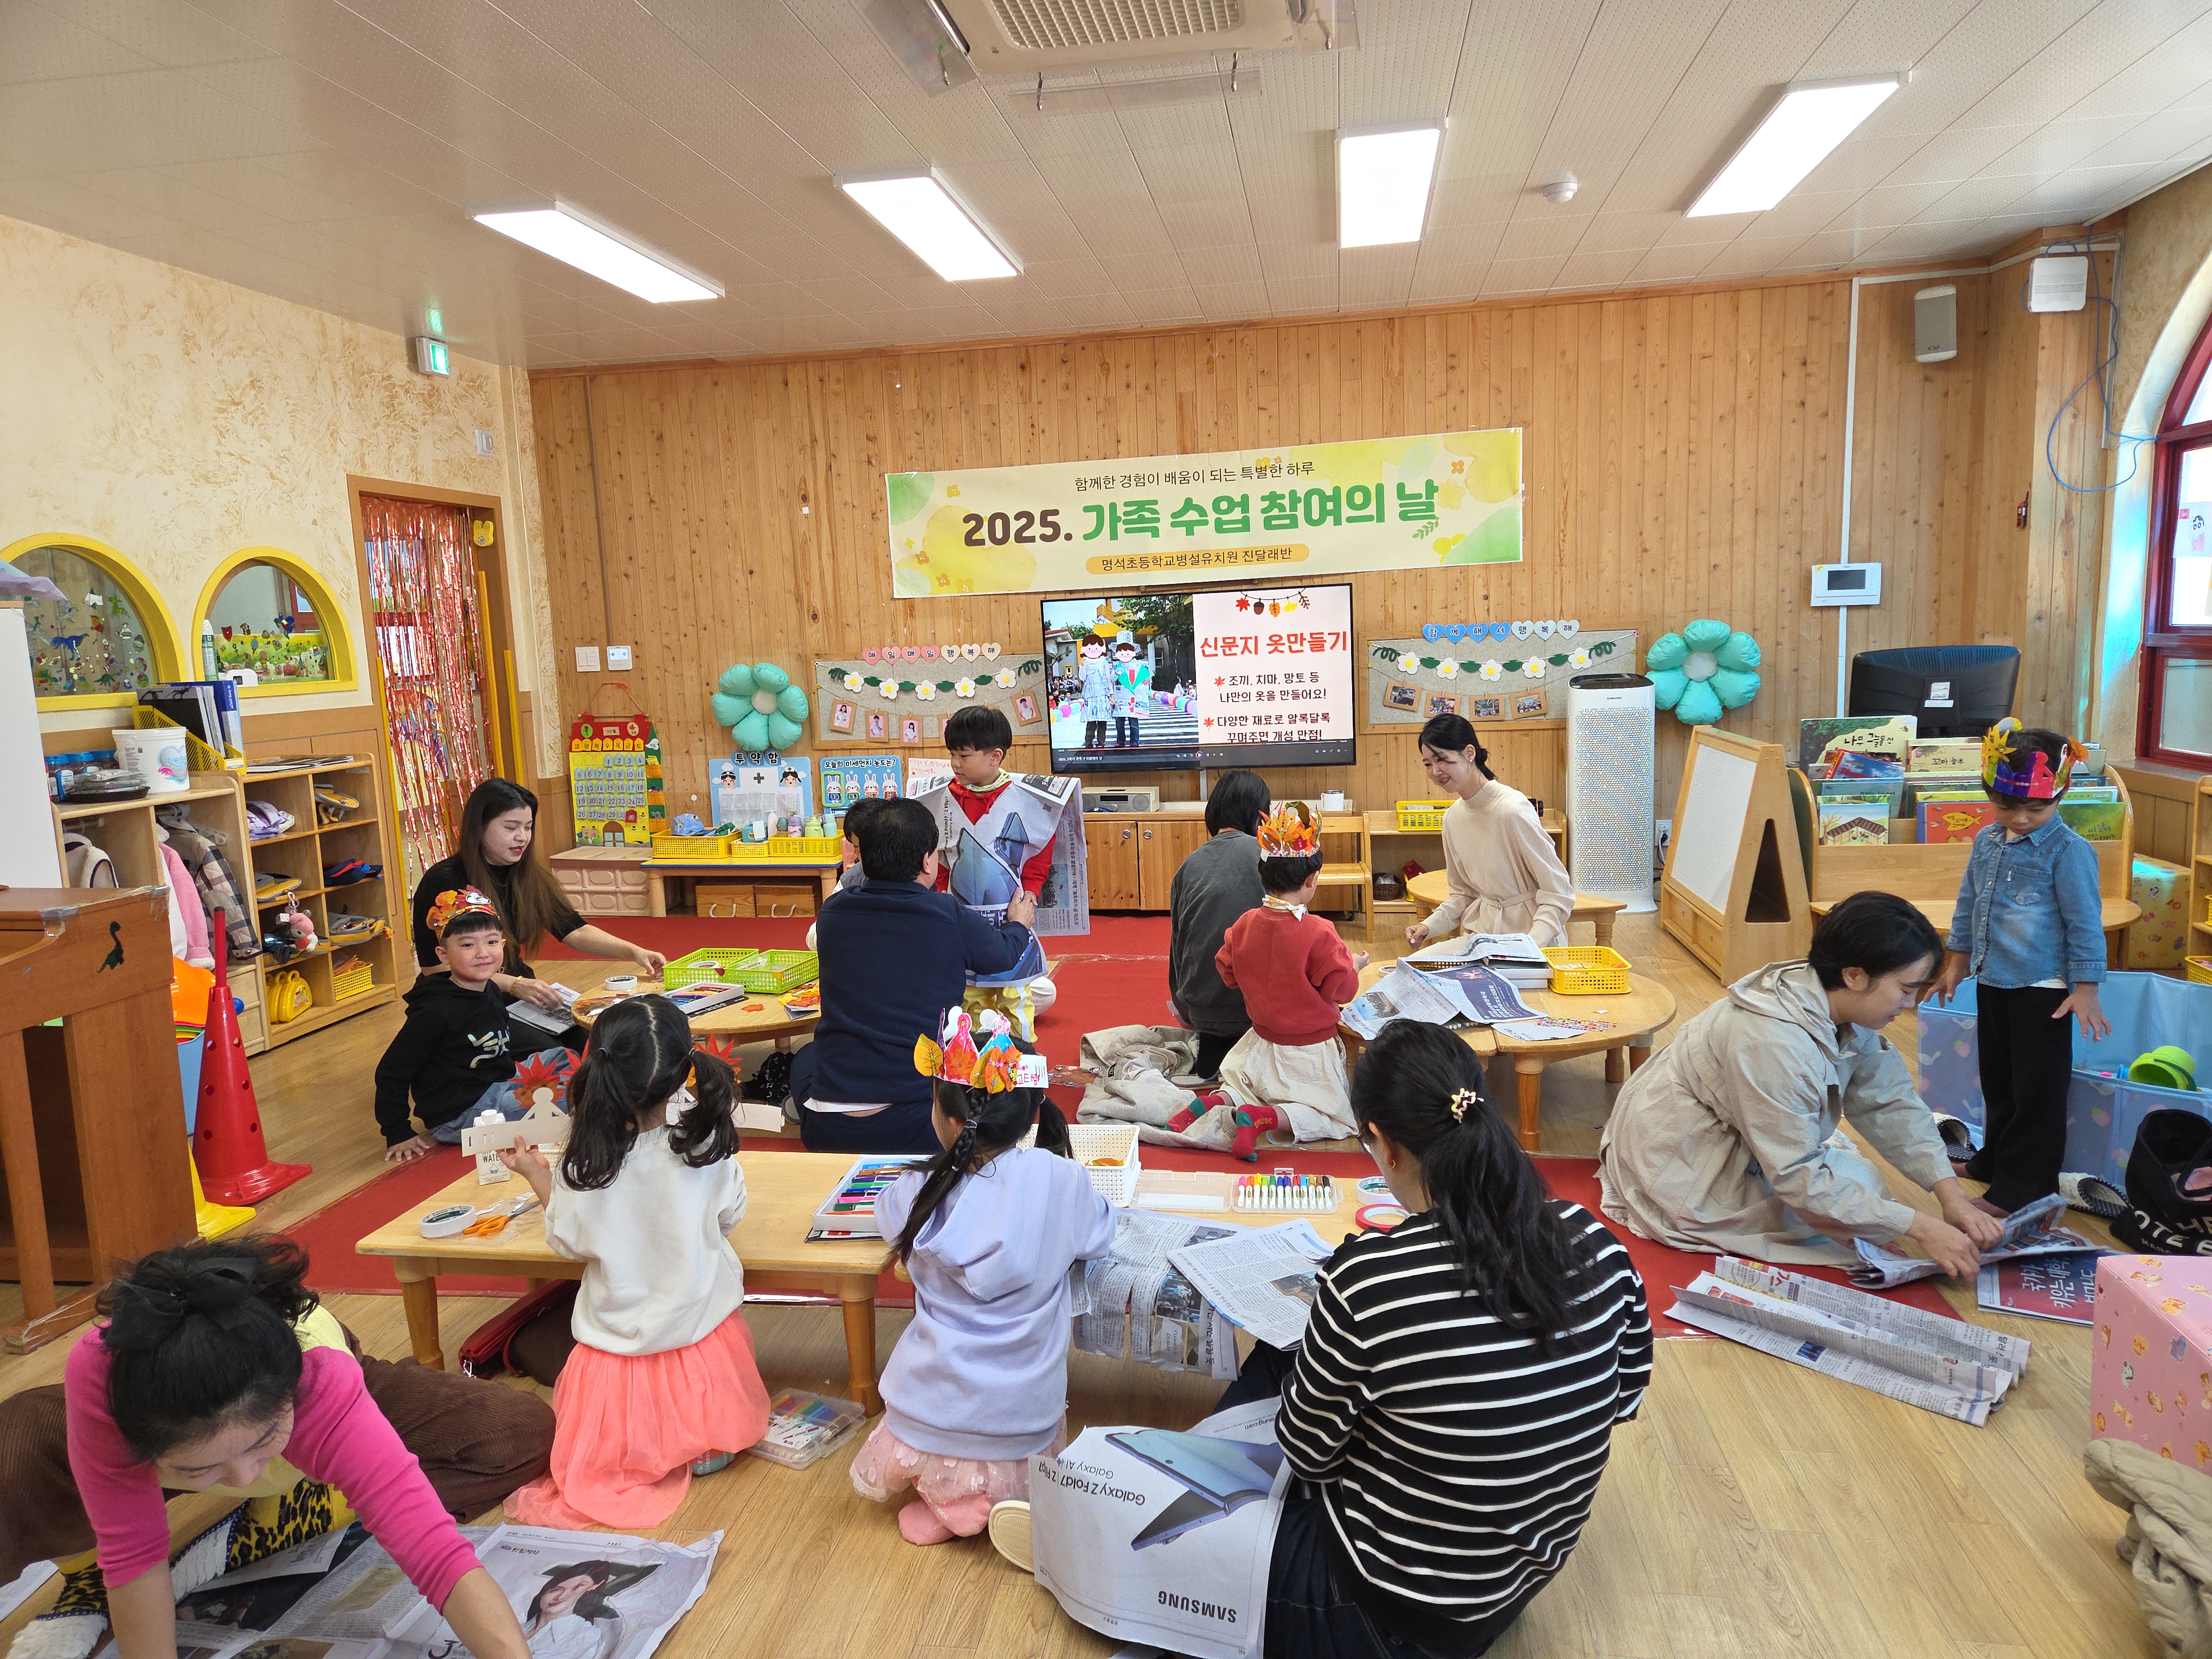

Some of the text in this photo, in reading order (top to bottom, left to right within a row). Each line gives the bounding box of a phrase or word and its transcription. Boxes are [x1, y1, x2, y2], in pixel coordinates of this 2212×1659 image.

[1075, 461, 1315, 492] 함께한 경험이 배움이 되는 특별한 하루
[962, 478, 1439, 547] 2025. 가족 수업 참여의 날
[1102, 547, 1293, 571] 명석초등학교병설유치원 진달래반
[1200, 631, 1347, 658] 신문지 옷만들기
[1284, 672, 1306, 684] 망토
[1309, 672, 1320, 683] 등
[1220, 688, 1327, 703] 나만의 옷을 만들어요!
[1217, 712, 1332, 728] 다양한 재료로 알록달록
[1226, 729, 1322, 743] 꾸며주면 개성 만점!
[1844, 735, 1864, 746] 나무
[735, 752, 779, 764] 투약함
[825, 761, 844, 769] 오늘의
[845, 760, 872, 768] 미세먼지
[873, 758, 896, 768] 농도는?
[2020, 1264, 2046, 1291] 국가가
[1052, 1470, 1057, 1482] Z
[1066, 1459, 1114, 1480] Galaxy AI
[1060, 1475, 1090, 1493] Fold7
[1090, 1483, 1099, 1495] Z
[1099, 1482, 1146, 1506] Galaxy
[1158, 1590, 1237, 1623] SAMSUNG
